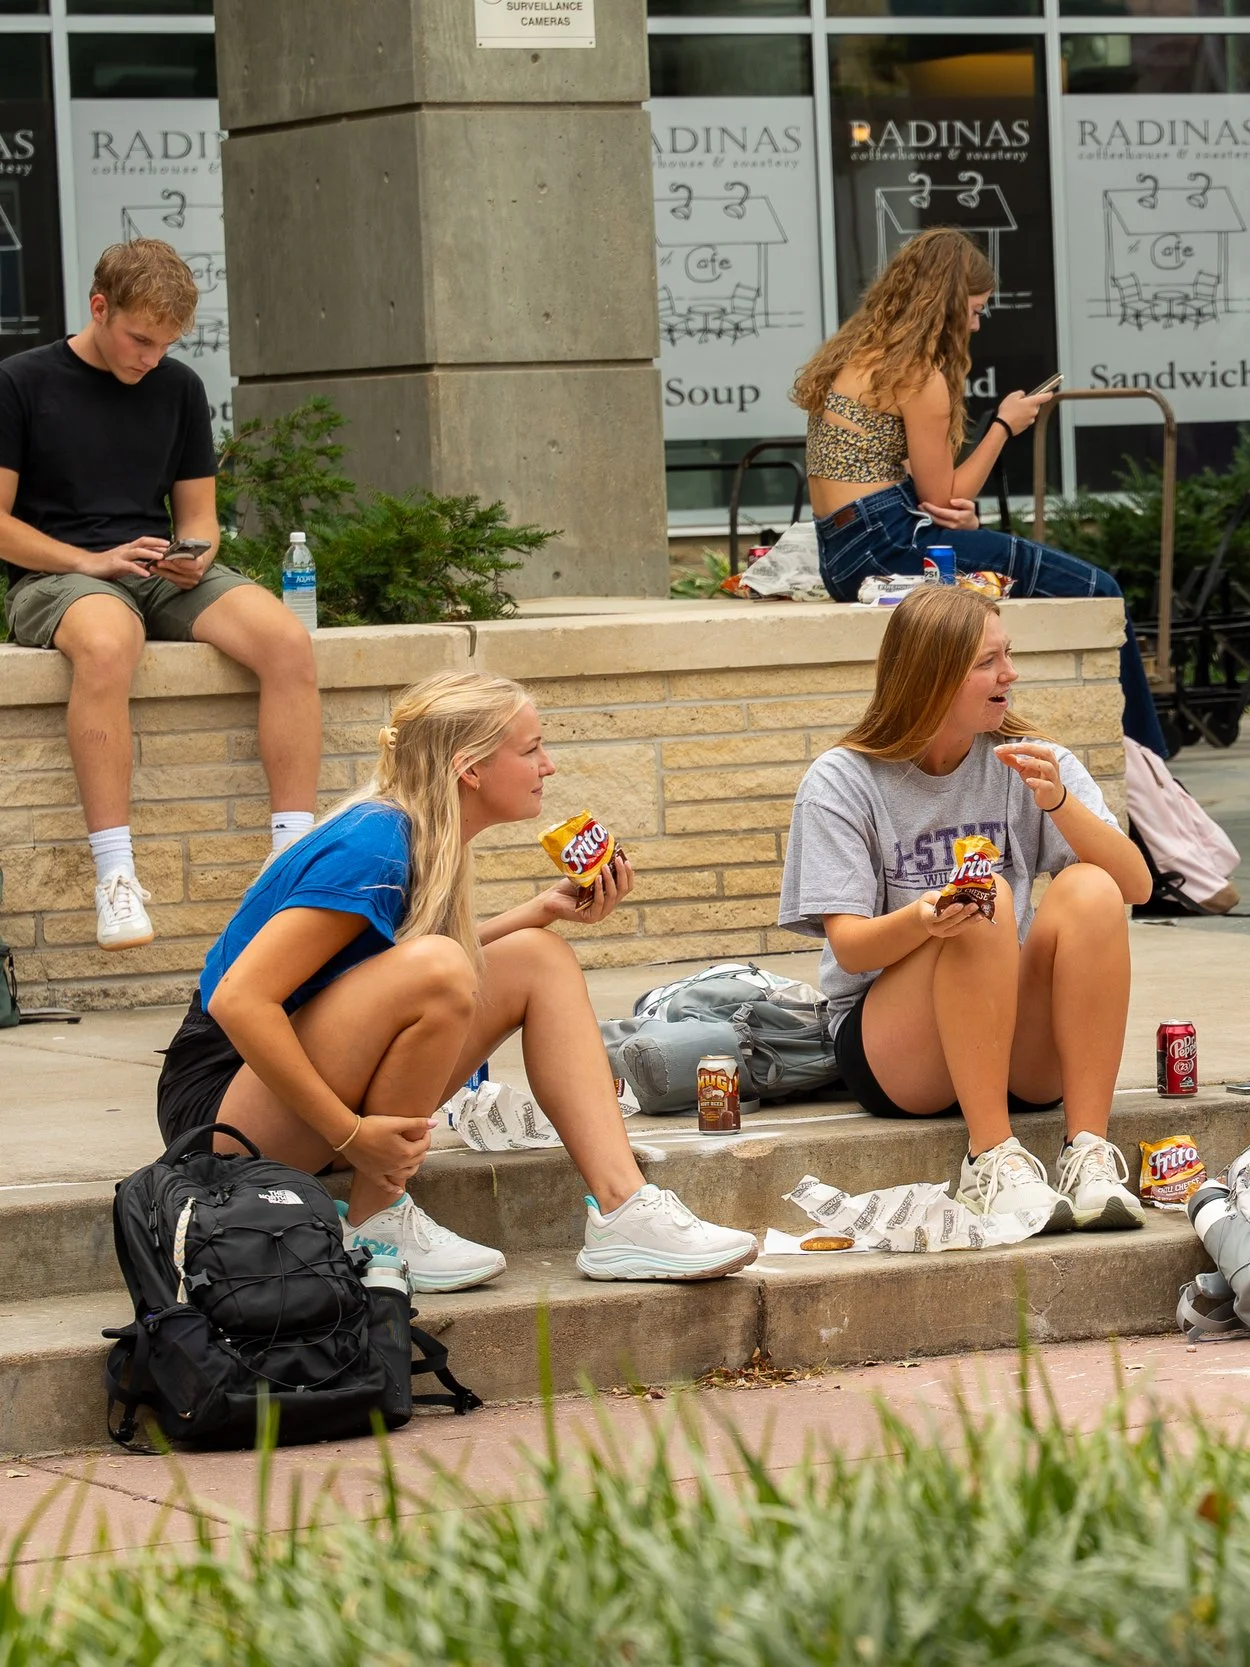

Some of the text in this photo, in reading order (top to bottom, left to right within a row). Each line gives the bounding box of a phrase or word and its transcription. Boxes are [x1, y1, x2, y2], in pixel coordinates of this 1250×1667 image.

[506, 2, 583, 11] SURVEILLANCE
[520, 17, 571, 26] CAMERAS
[849, 119, 1031, 149] RADINAS
[850, 148, 943, 162] coffeehouse
[966, 150, 1029, 163] roastery
[1078, 148, 1170, 161] coffeehouse
[91, 161, 199, 176] coffeehouse
[665, 377, 761, 413] Soup
[560, 822, 609, 874] Frito
[1183, 1035, 1195, 1048] Dr
[1148, 1146, 1200, 1180] Frito
[352, 1235, 399, 1256] HOKA
